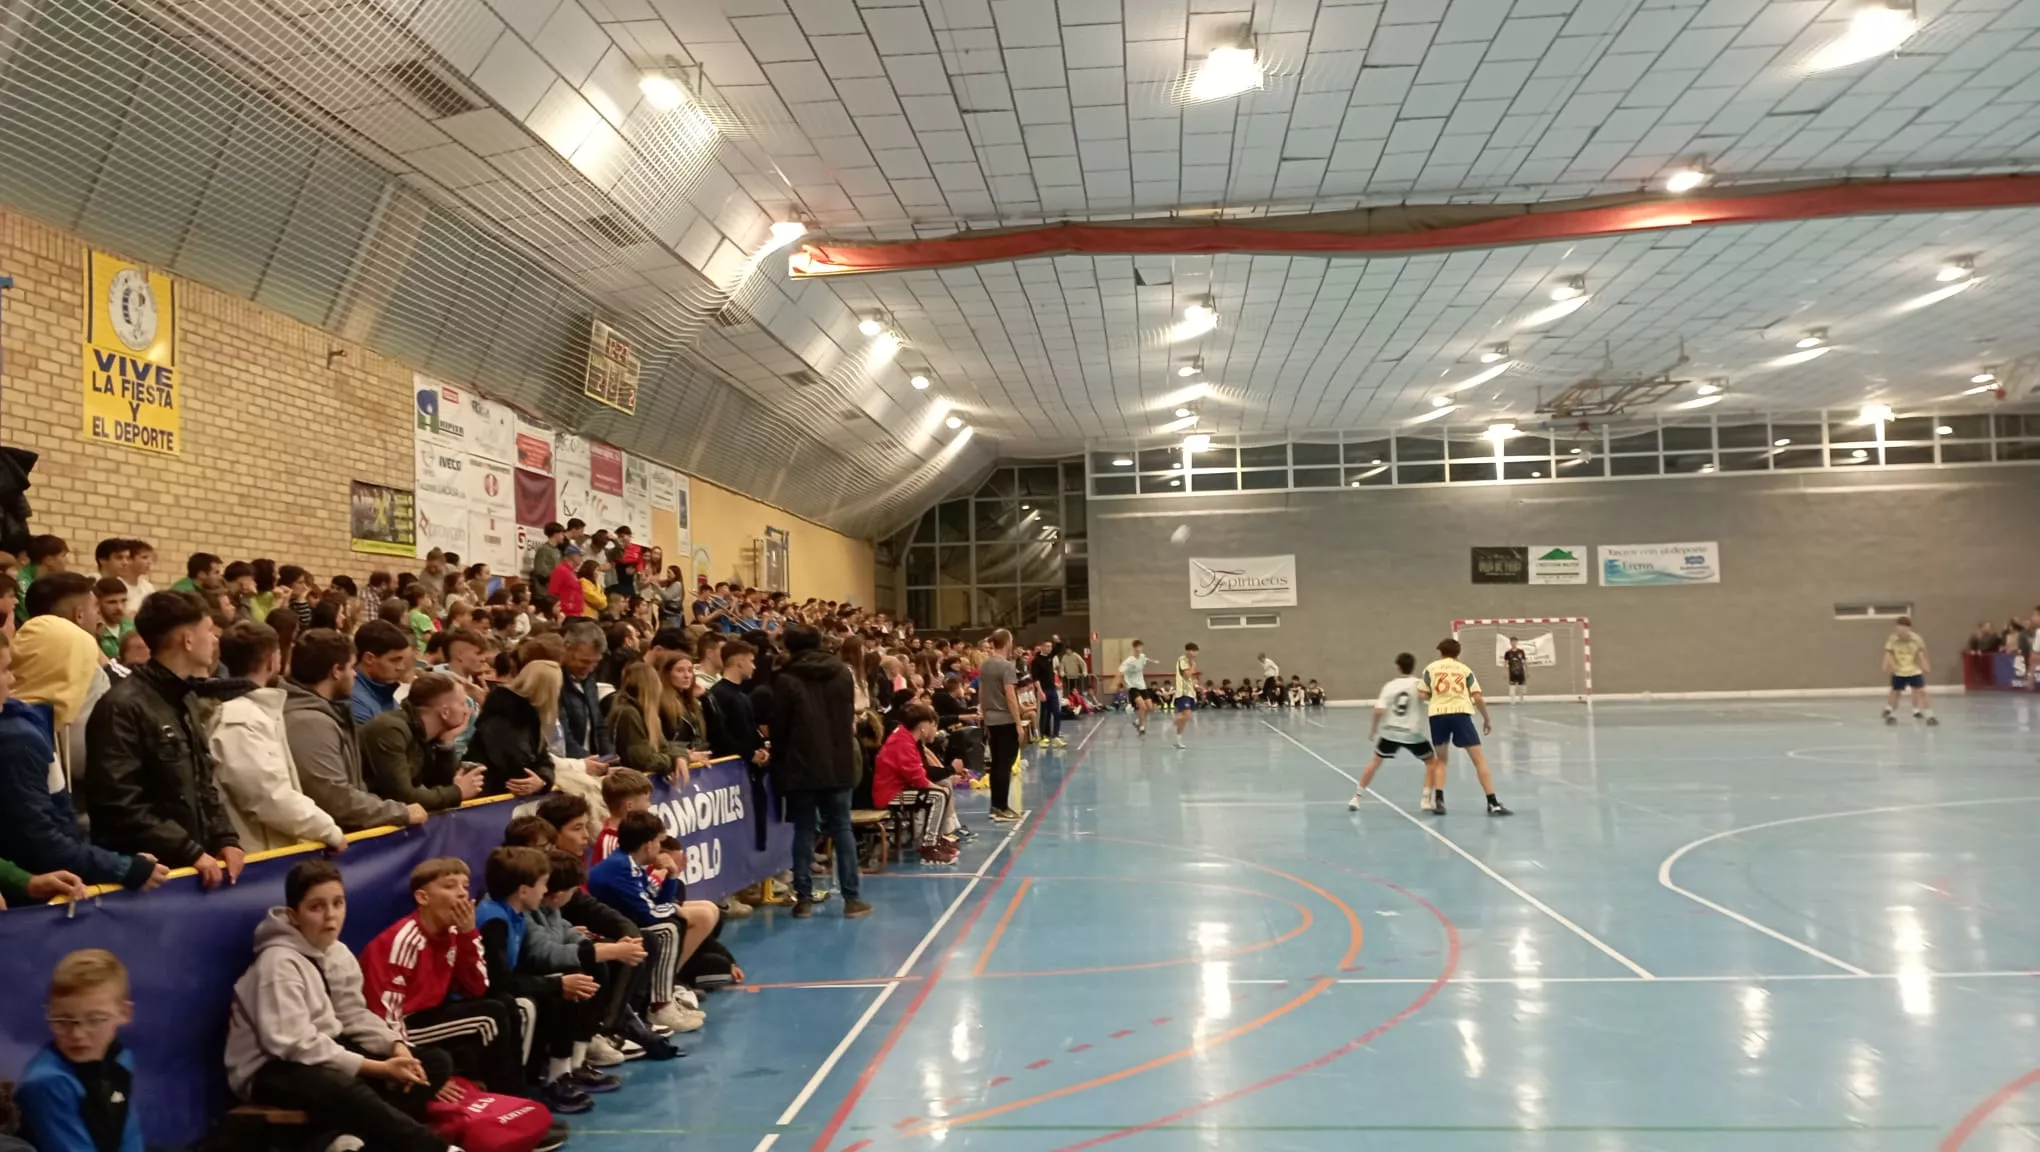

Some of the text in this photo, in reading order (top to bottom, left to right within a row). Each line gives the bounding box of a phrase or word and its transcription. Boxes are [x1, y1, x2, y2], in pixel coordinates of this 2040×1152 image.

[93, 348, 174, 389] VIVE
[92, 371, 174, 409] LA FIESTA
[129, 401, 141, 422] Y
[92, 415, 174, 451] EL DEPORTE
[439, 455, 461, 471] IVECO
[1393, 691, 1409, 717] 9
[680, 838, 722, 885] BLO
